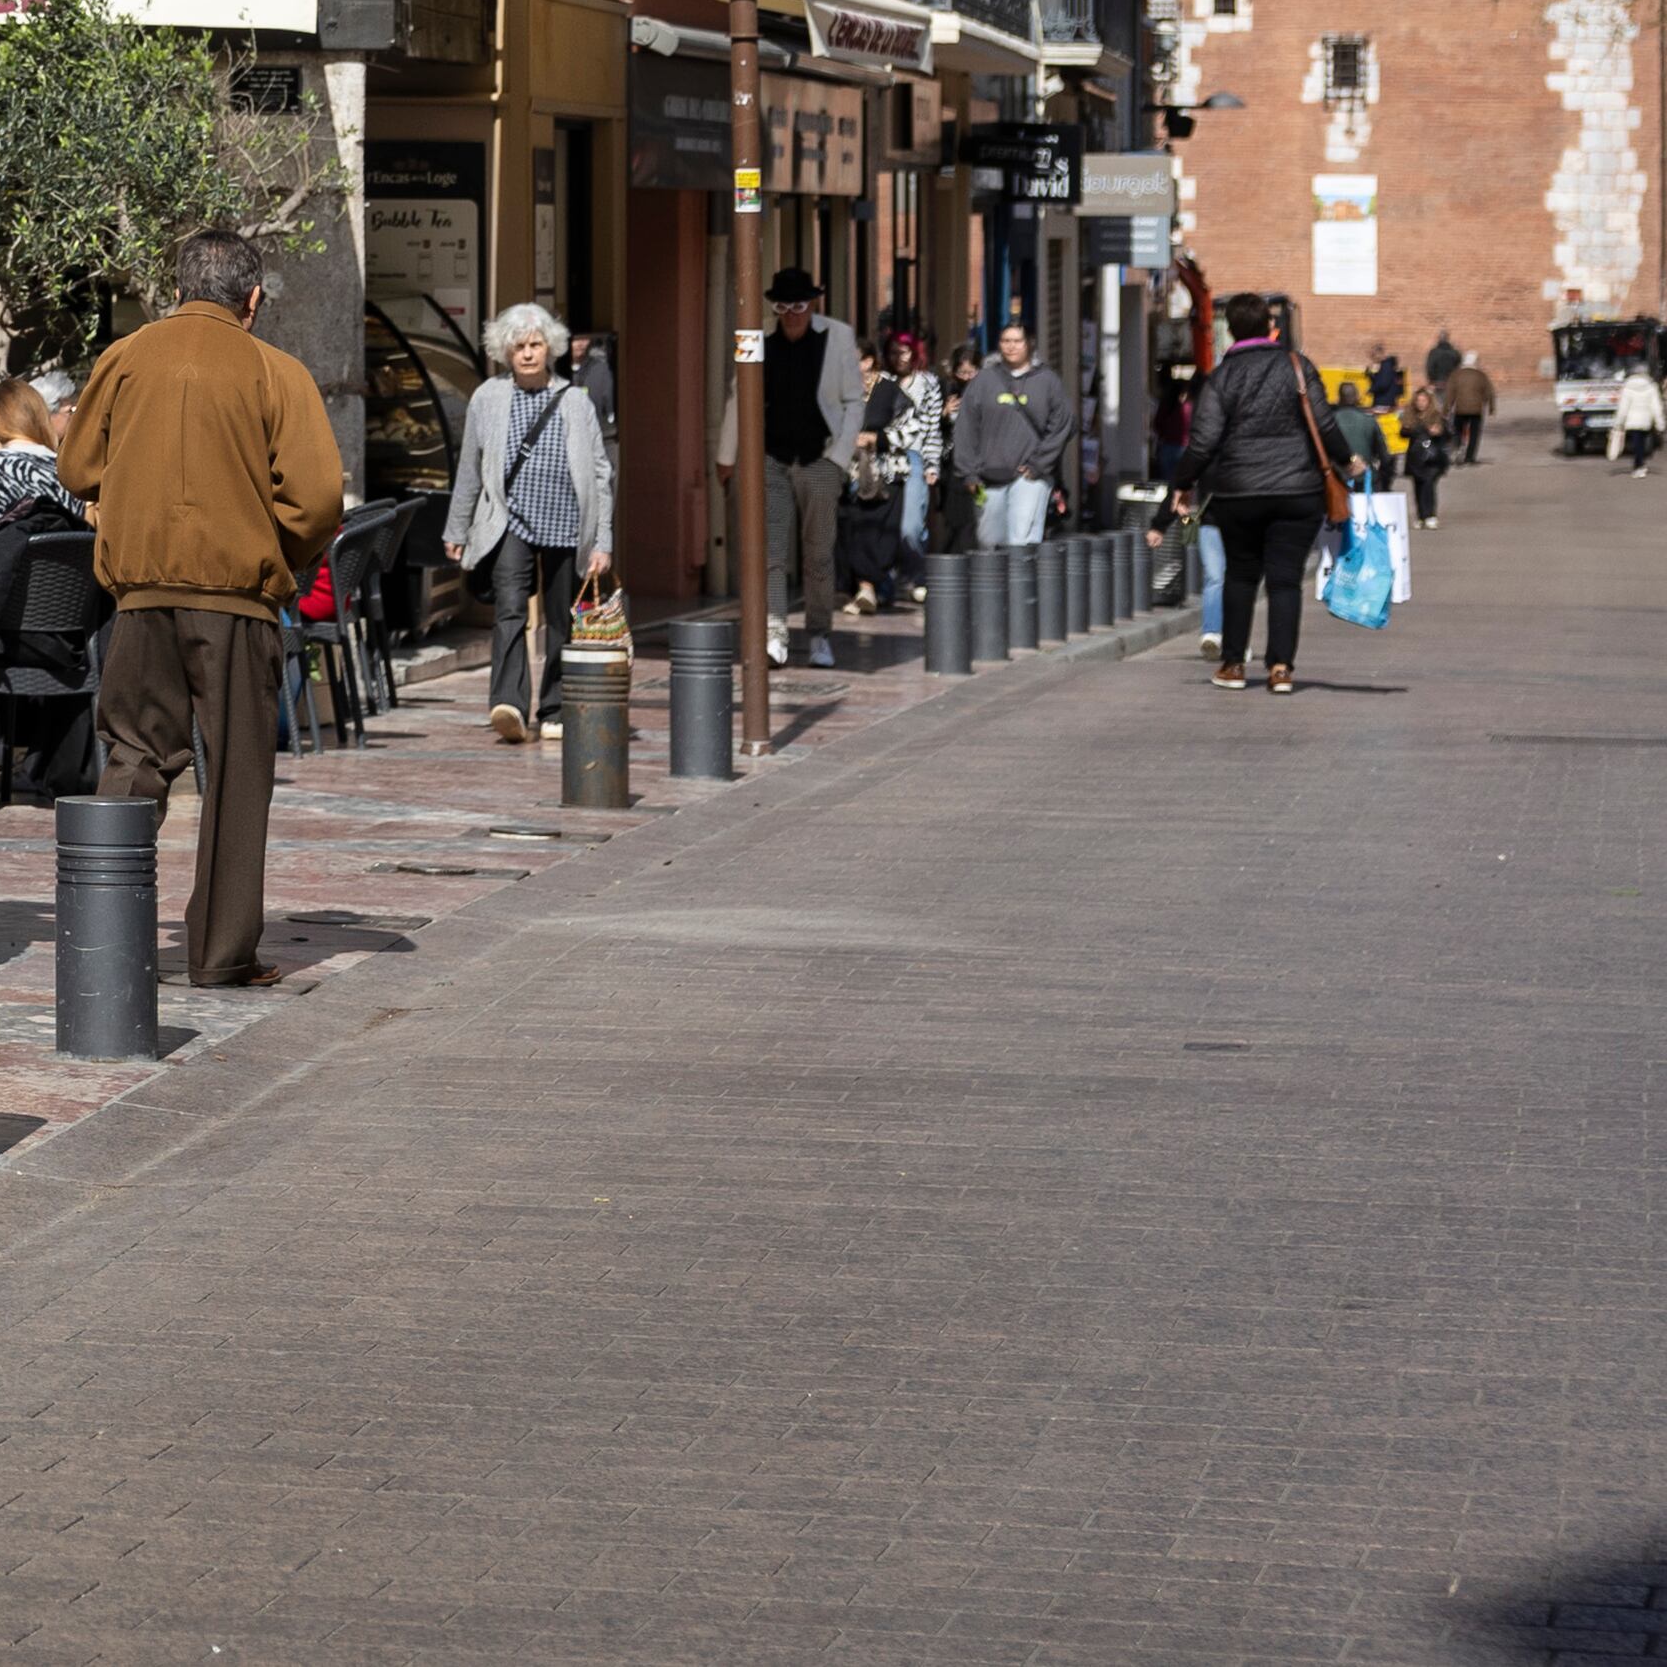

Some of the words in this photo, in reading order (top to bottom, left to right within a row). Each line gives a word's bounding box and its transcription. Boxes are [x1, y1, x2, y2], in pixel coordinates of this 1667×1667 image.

[427, 170, 458, 186] Loge
[1013, 172, 1070, 198] David
[371, 209, 422, 232] Bubble
[426, 208, 453, 229] Tea
